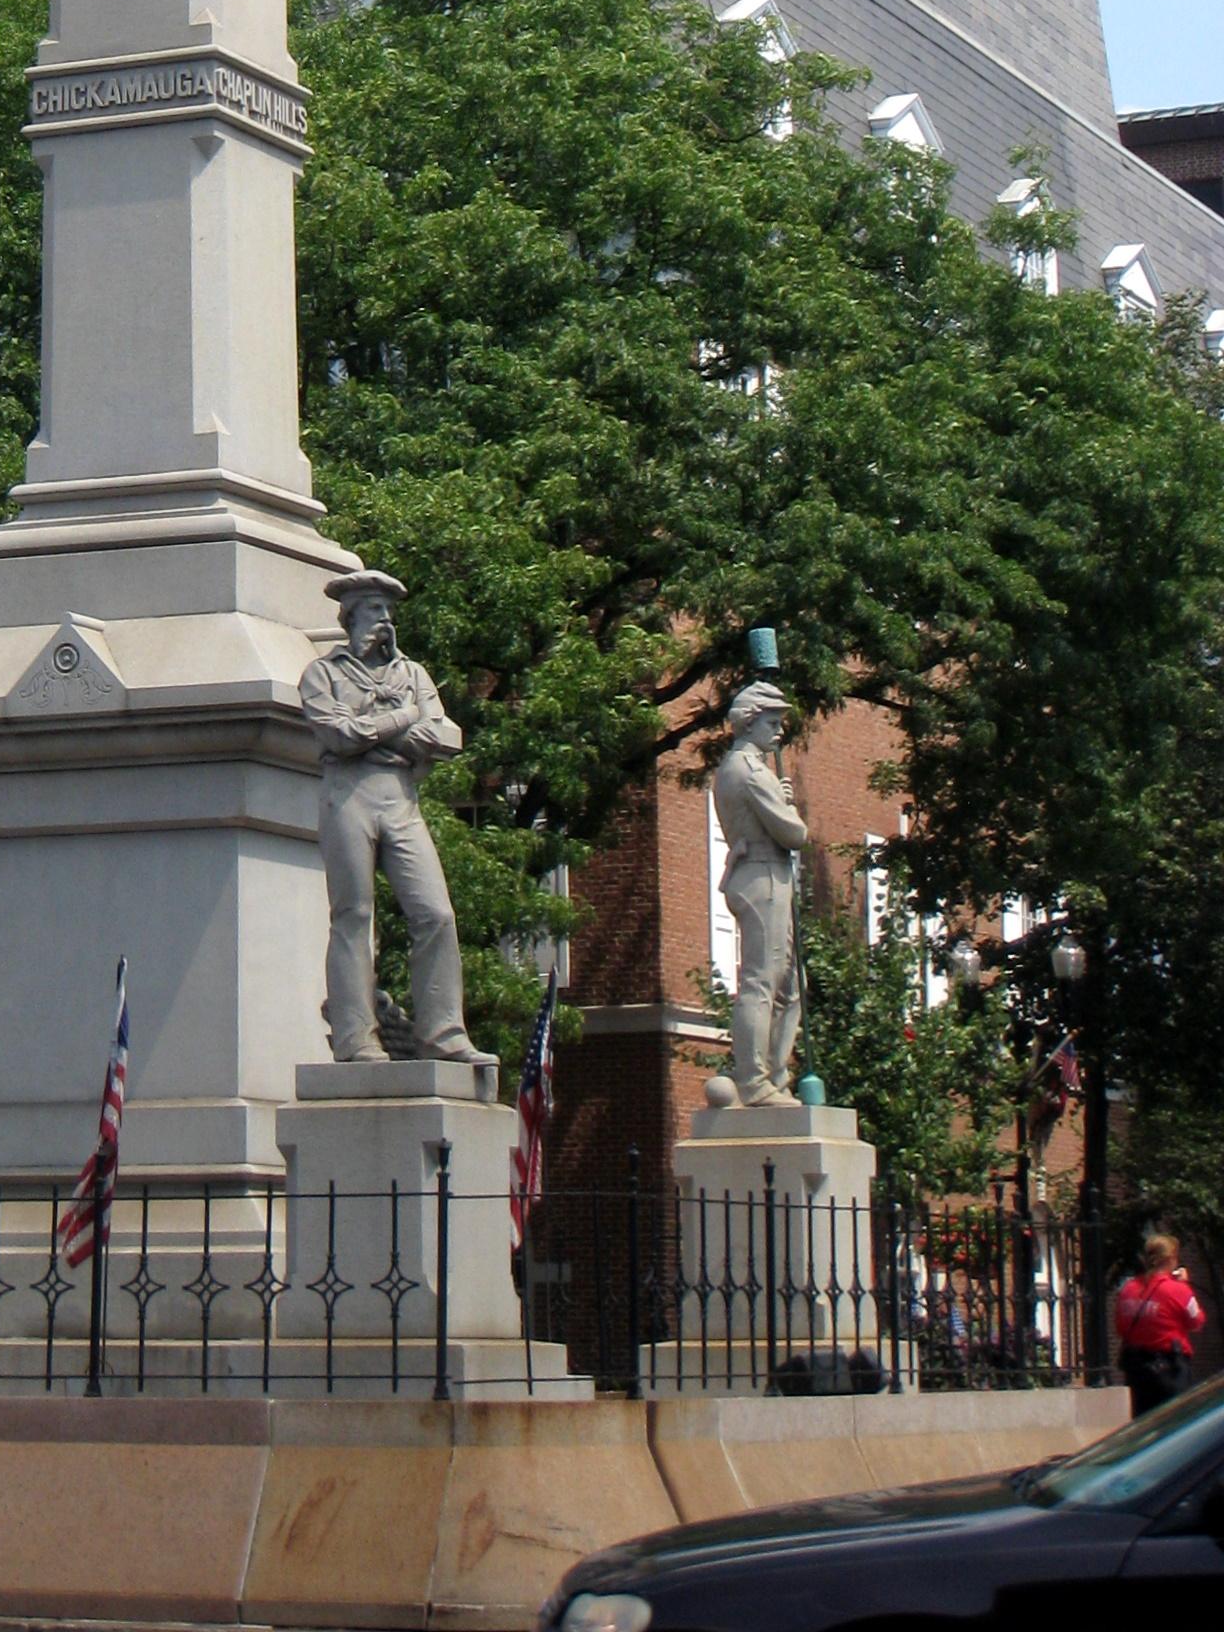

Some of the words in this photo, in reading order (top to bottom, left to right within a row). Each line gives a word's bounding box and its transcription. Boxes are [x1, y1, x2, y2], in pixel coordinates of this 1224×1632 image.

[32, 68, 214, 115] CHICKAMAUGA
[219, 69, 272, 122] CHAPLIN
[274, 92, 308, 135] HILLS
